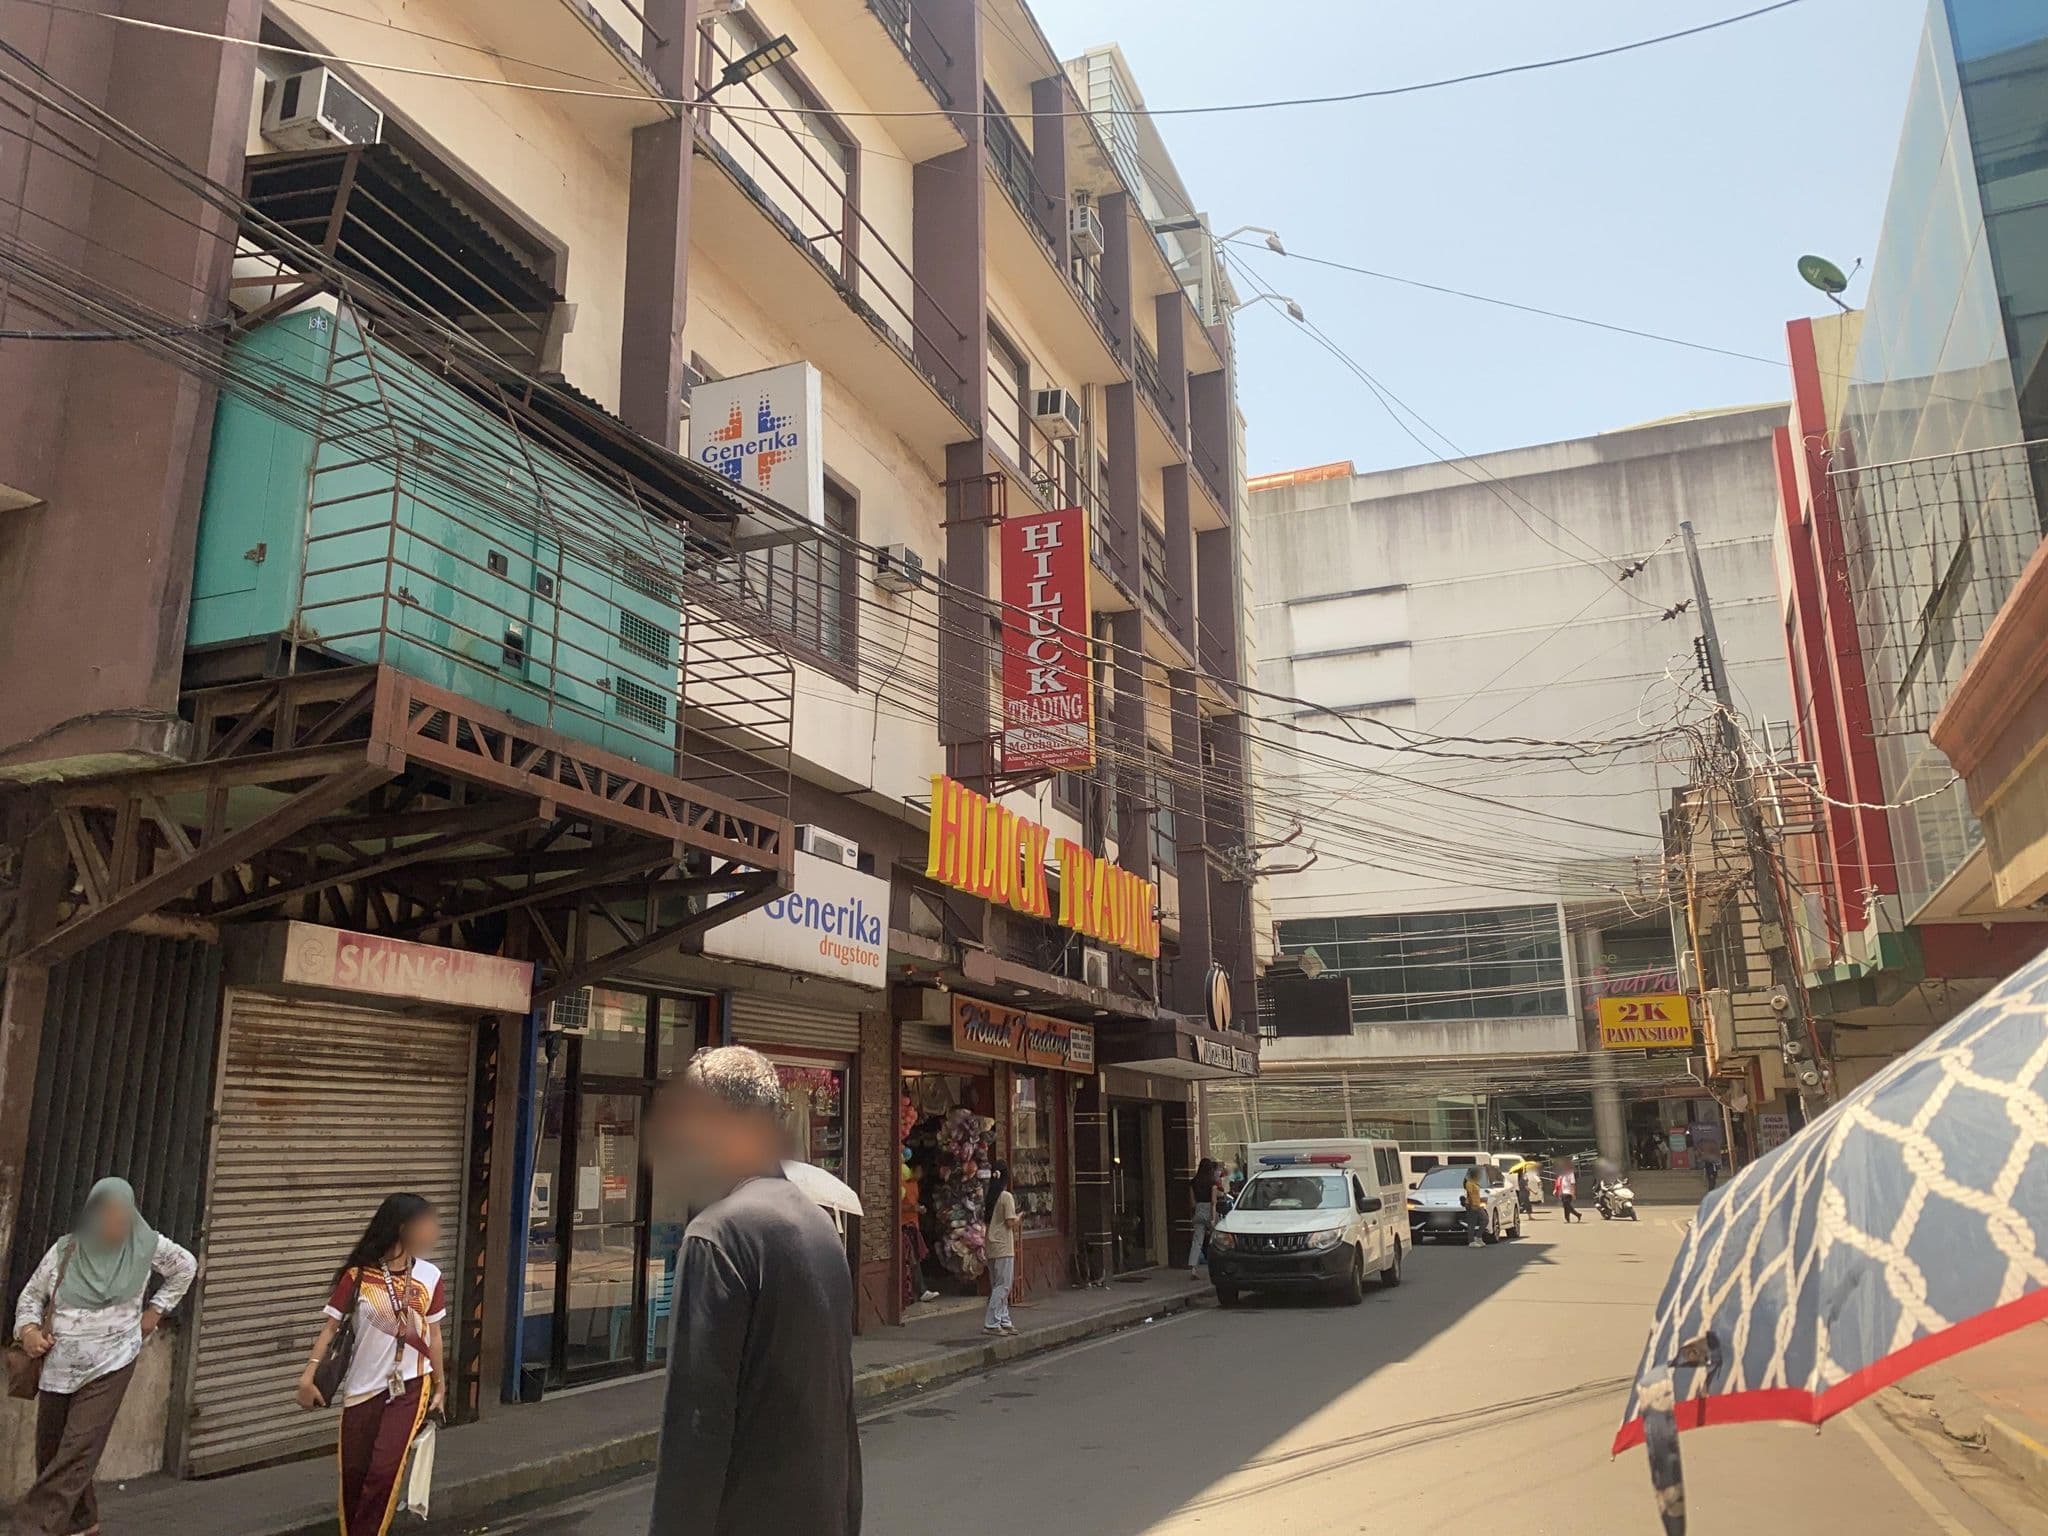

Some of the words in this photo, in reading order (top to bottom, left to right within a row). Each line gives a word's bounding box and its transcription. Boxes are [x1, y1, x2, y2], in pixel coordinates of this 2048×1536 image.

[702, 431, 798, 463] Generika
[1021, 520, 1068, 695] HILUCK
[1008, 693, 1083, 724] TRADING
[1008, 737, 1088, 752] Merchan
[1023, 725, 1069, 740] Geal
[925, 774, 1051, 918] HILUCK
[1055, 838, 1160, 958] TRADING
[819, 935, 880, 968] drugstore
[1617, 1002, 1671, 1023] 2K
[1604, 1026, 1690, 1043] PAWNSHOP
[1341, 1128, 1394, 1140] EST
